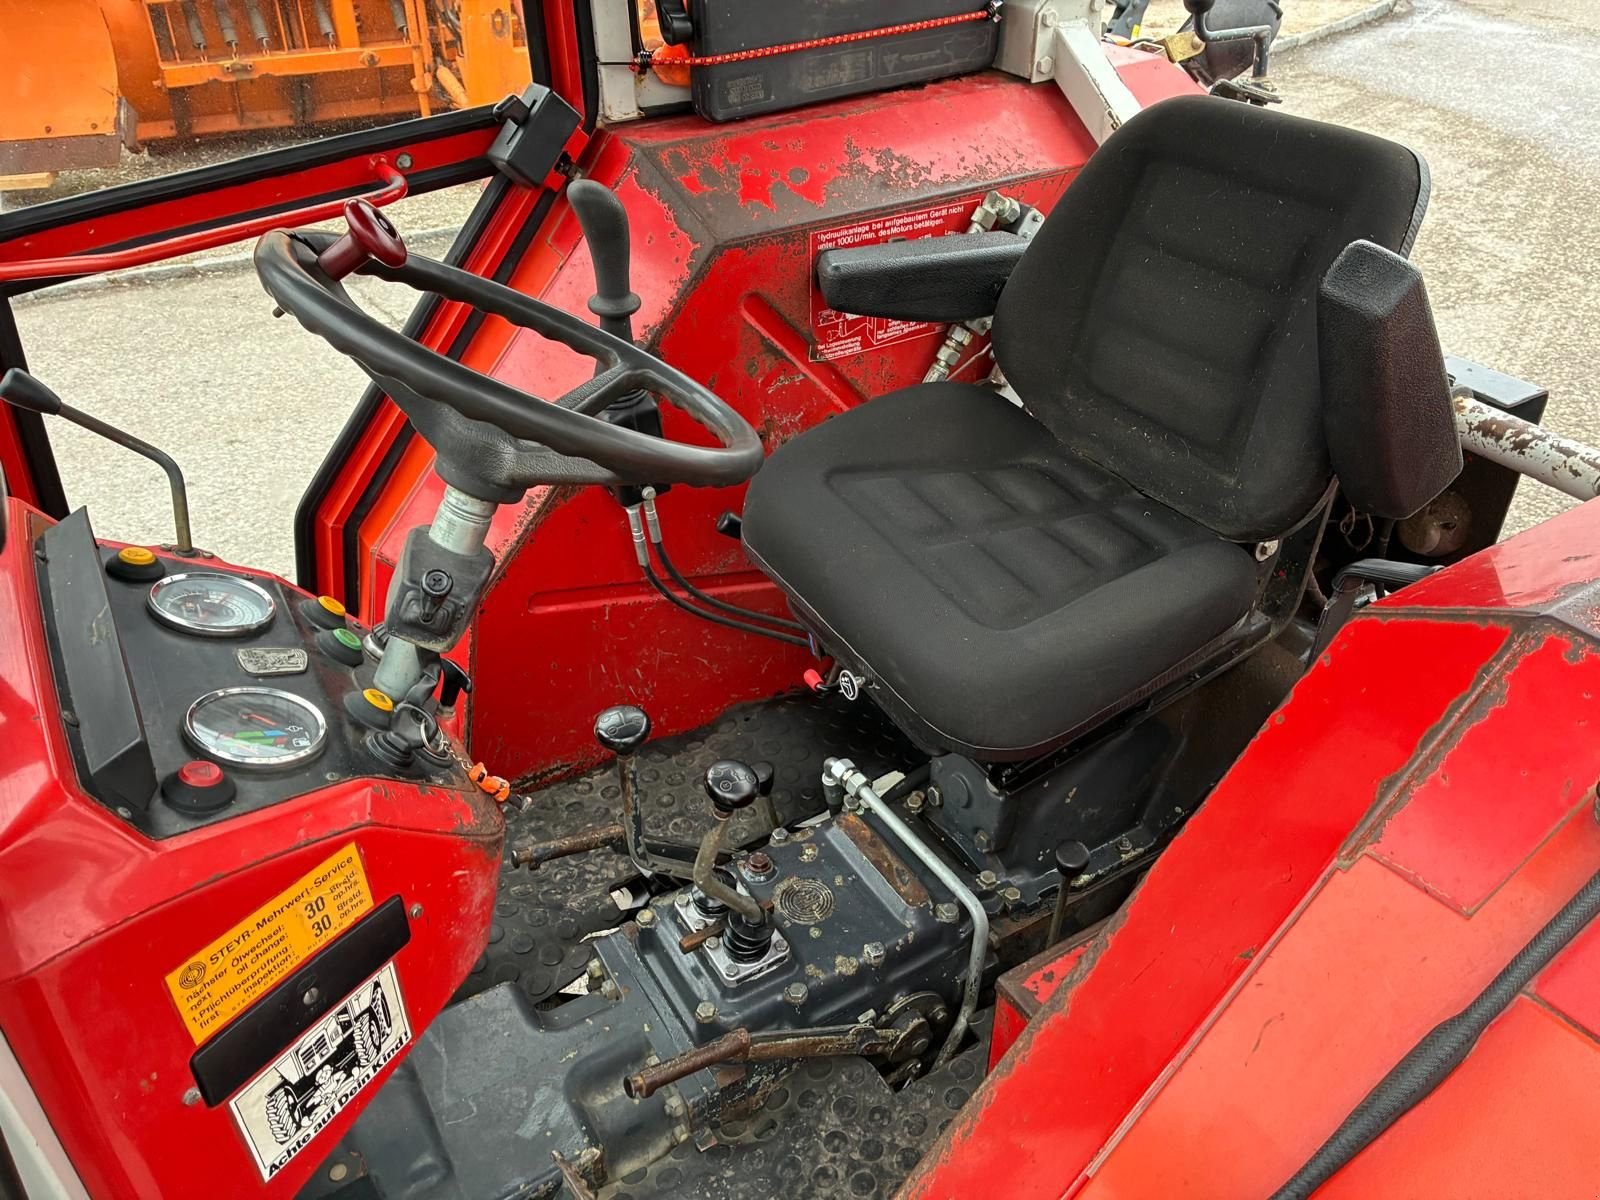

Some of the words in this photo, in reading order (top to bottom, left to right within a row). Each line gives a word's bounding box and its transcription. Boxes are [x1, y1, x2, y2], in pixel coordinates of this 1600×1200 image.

[817, 240, 836, 250] unter
[878, 228, 890, 237] des
[891, 223, 913, 235] Motors
[914, 218, 944, 231] betätigen.
[872, 221, 883, 230] bei
[885, 213, 928, 228] aufgebautem
[930, 208, 948, 218] Gerät
[948, 205, 964, 215] nicht
[186, 967, 228, 1003] nächster
[231, 923, 286, 968] Ölwechsel:
[304, 895, 326, 920] 30
[311, 913, 332, 938] 30
[190, 991, 213, 1012] next
[236, 962, 249, 976] oil
[250, 932, 289, 964] change:
[199, 1010, 221, 1030] first
[243, 950, 296, 995] inspektion:
[269, 1131, 312, 1177] Achte
[313, 1104, 338, 1132] auf
[338, 1072, 371, 1107] Dein
[372, 1031, 409, 1074] Kind!
